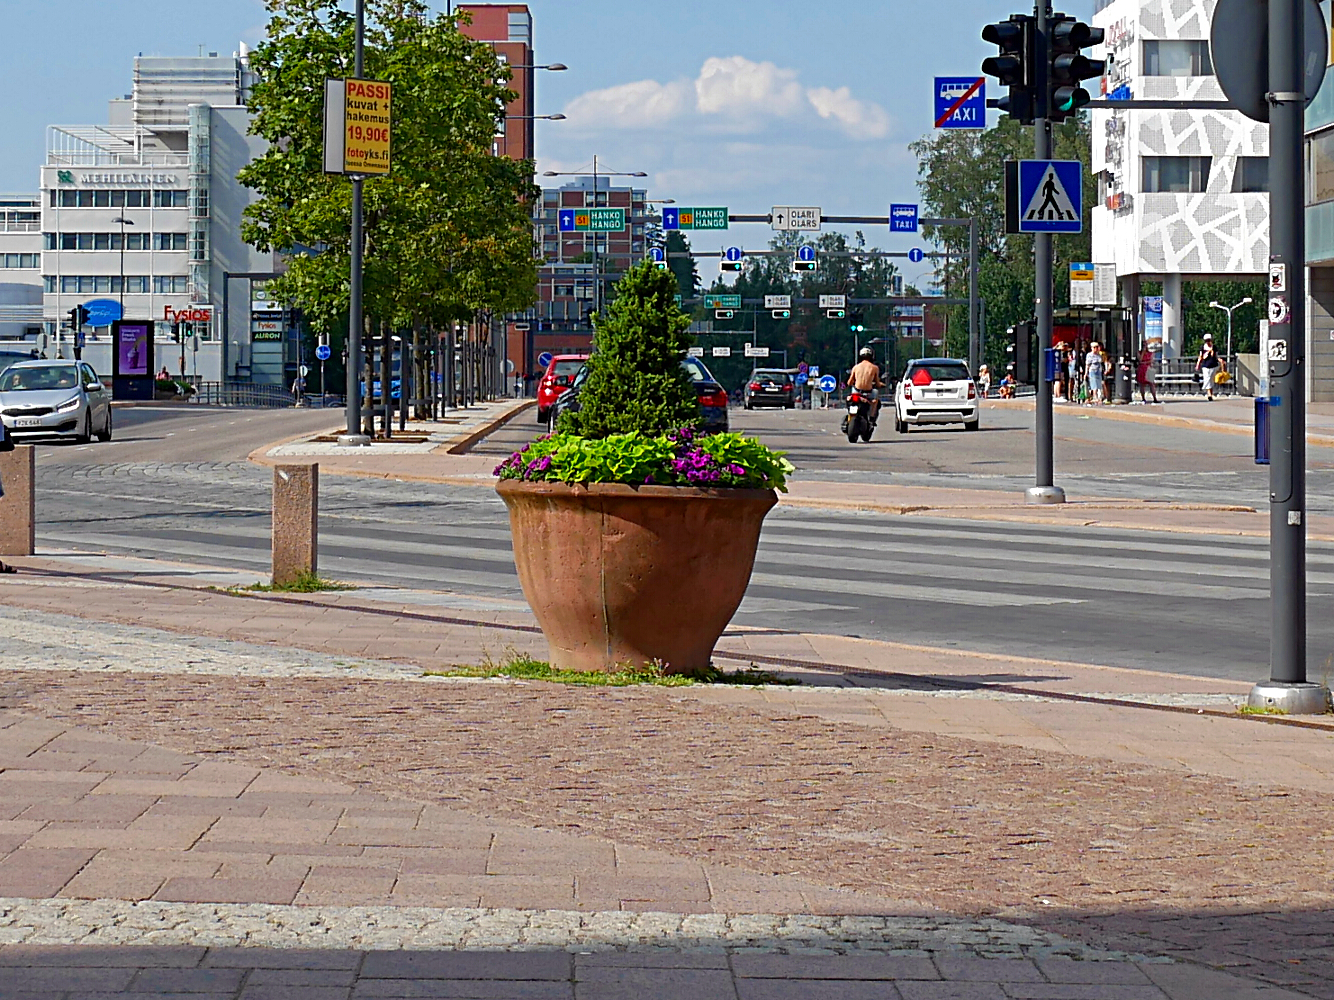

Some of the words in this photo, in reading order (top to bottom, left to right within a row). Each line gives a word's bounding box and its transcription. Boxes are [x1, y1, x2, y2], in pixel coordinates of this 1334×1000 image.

[347, 82, 389, 100] PASSI
[347, 97, 378, 111] kuvat
[347, 110, 390, 124] hakemus
[347, 125, 389, 143] 19,90€
[347, 147, 389, 160] fotoyks.fi
[80, 173, 176, 184] MEHILÄINEN
[577, 215, 587, 225] 51
[591, 211, 621, 219] HANKO
[681, 214, 690, 223] 51
[695, 210, 725, 218] HANKO
[791, 210, 815, 219] OLARI
[791, 219, 817, 228] OLARS
[894, 220, 913, 229] TAXI
[164, 305, 211, 322] Fysios
